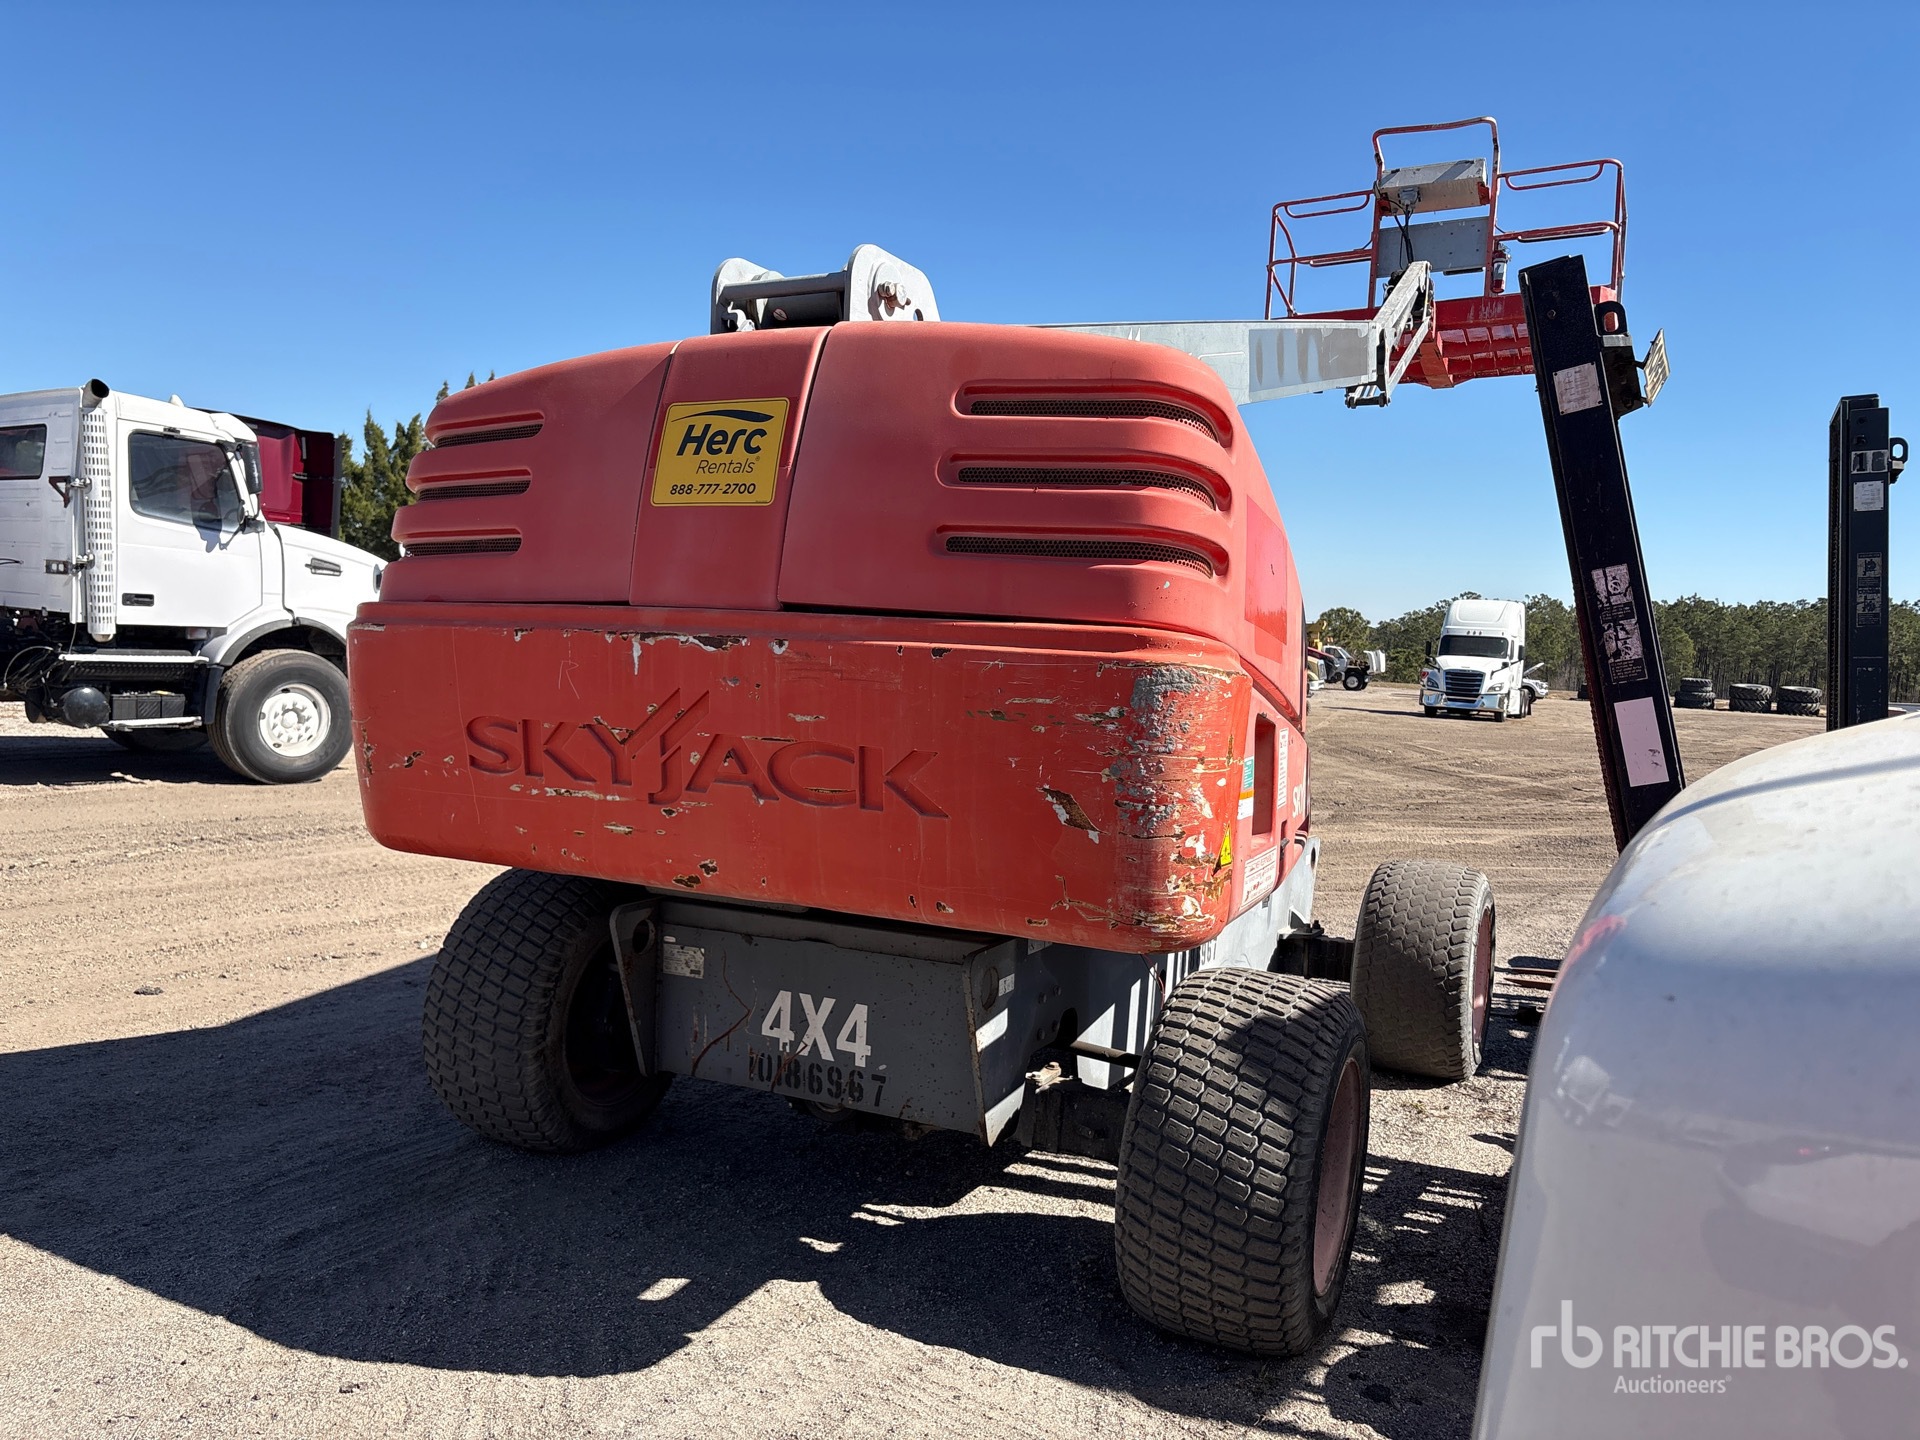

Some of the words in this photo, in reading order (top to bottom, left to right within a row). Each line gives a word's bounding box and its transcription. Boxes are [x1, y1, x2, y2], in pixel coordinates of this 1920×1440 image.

[676, 424, 768, 456] Herc
[670, 482, 757, 495] 888-777-2700
[466, 687, 951, 820] SKYJACK
[762, 990, 872, 1068] 4X4
